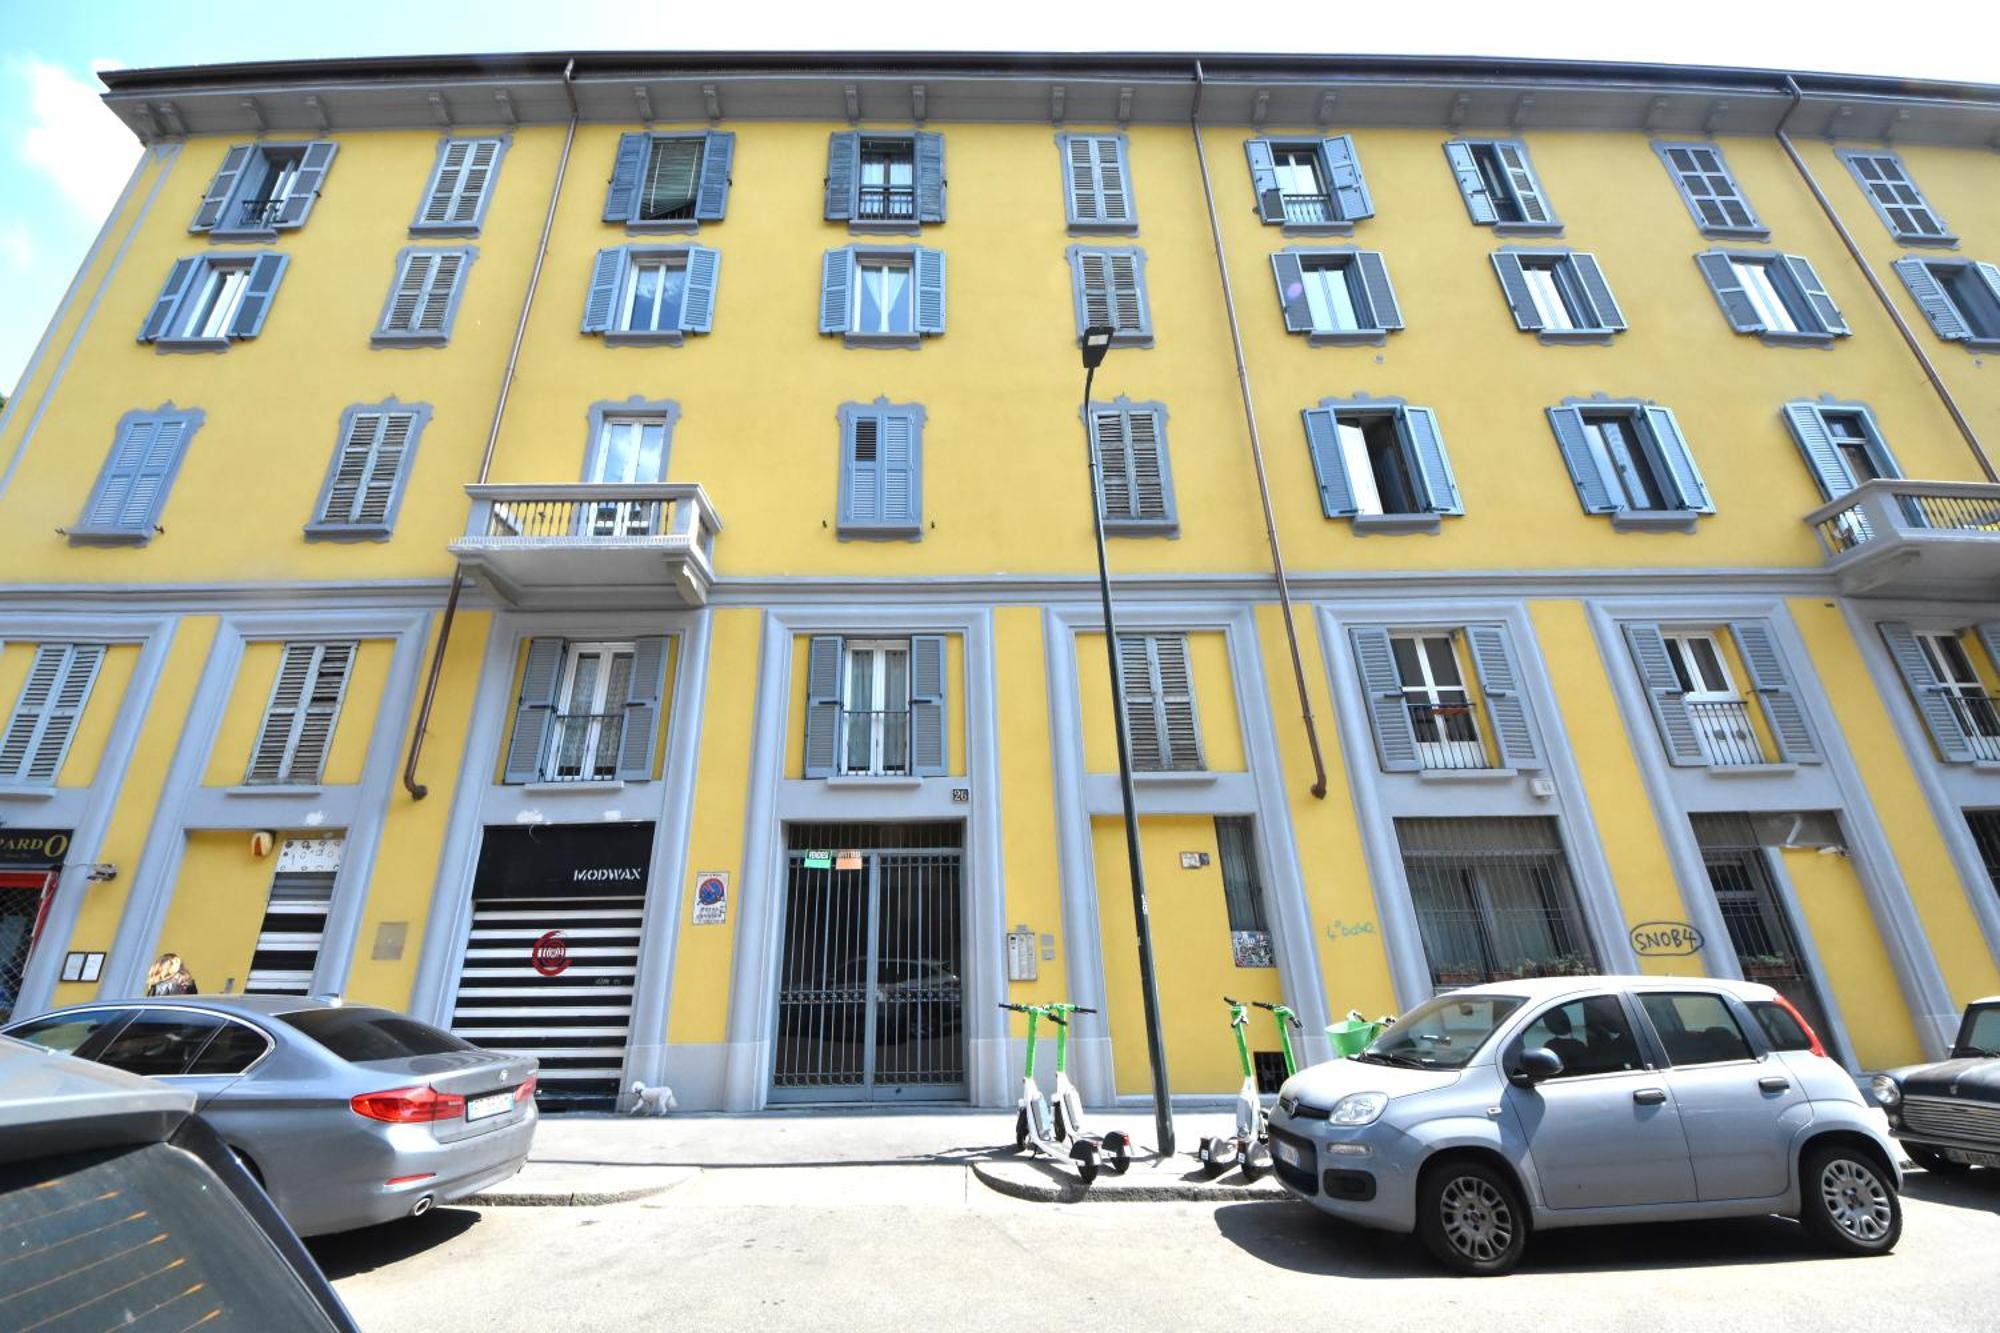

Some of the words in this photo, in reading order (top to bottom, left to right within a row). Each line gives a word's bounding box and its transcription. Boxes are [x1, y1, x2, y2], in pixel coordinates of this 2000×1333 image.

[954, 789, 968, 801] 26
[574, 868, 641, 881] MODWAX
[1634, 928, 1697, 951] SNOB4
